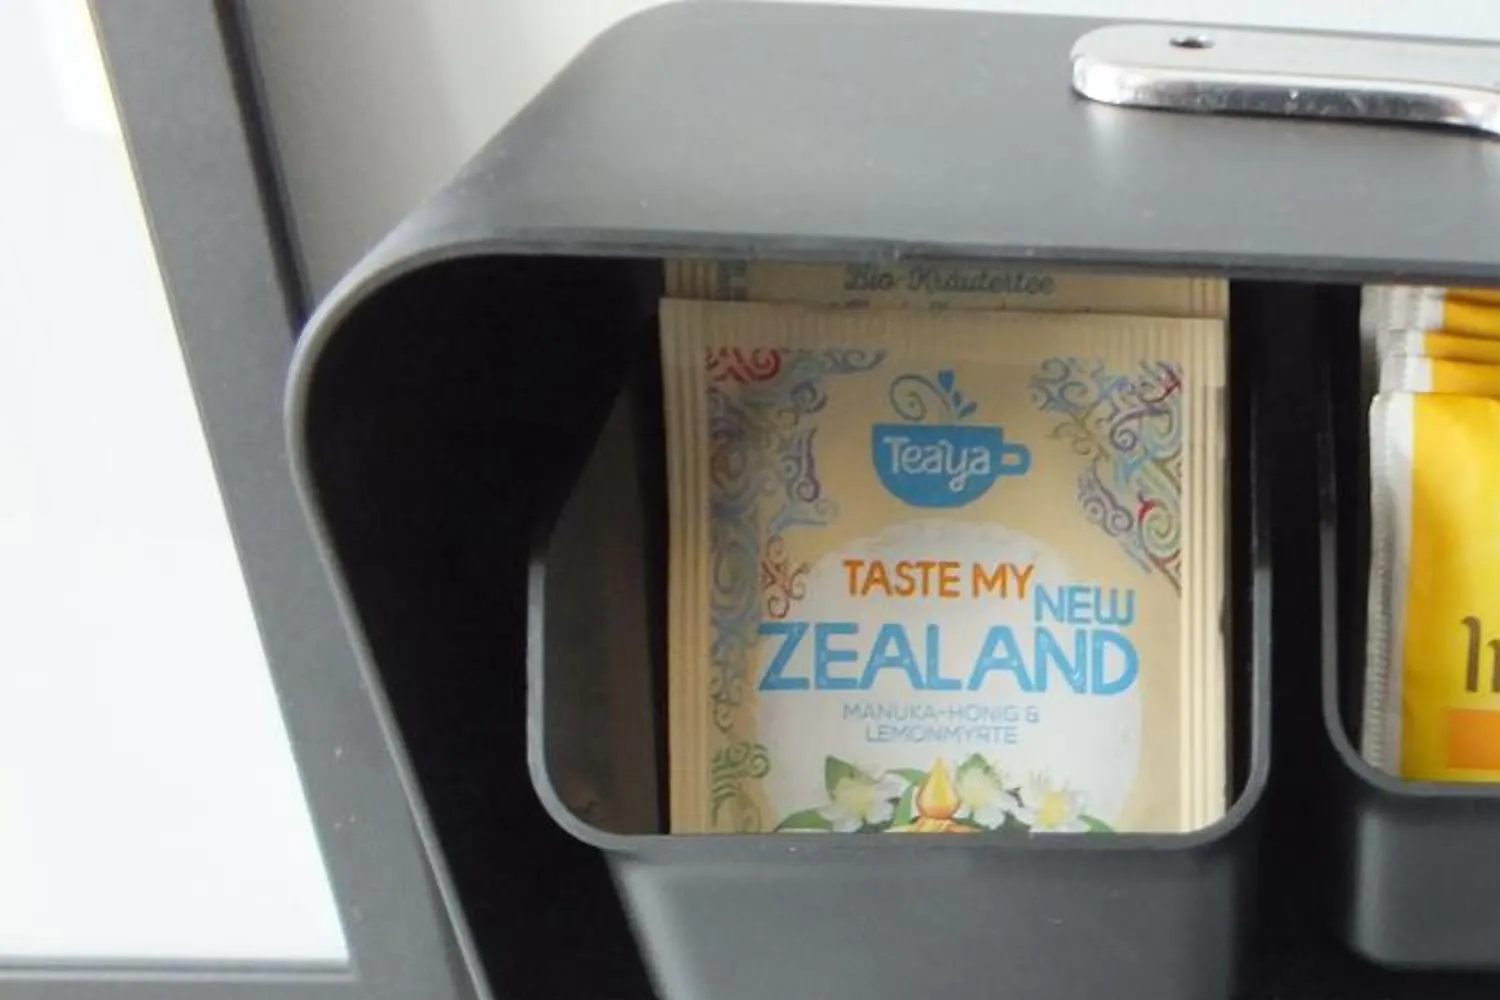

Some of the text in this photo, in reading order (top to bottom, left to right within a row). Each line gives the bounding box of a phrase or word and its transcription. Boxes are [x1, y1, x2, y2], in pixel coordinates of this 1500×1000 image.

[882, 436, 991, 492] Teaya
[842, 560, 1036, 600] TASTE MY
[1034, 585, 1136, 626] NEW
[756, 622, 1140, 695] ZEALAND
